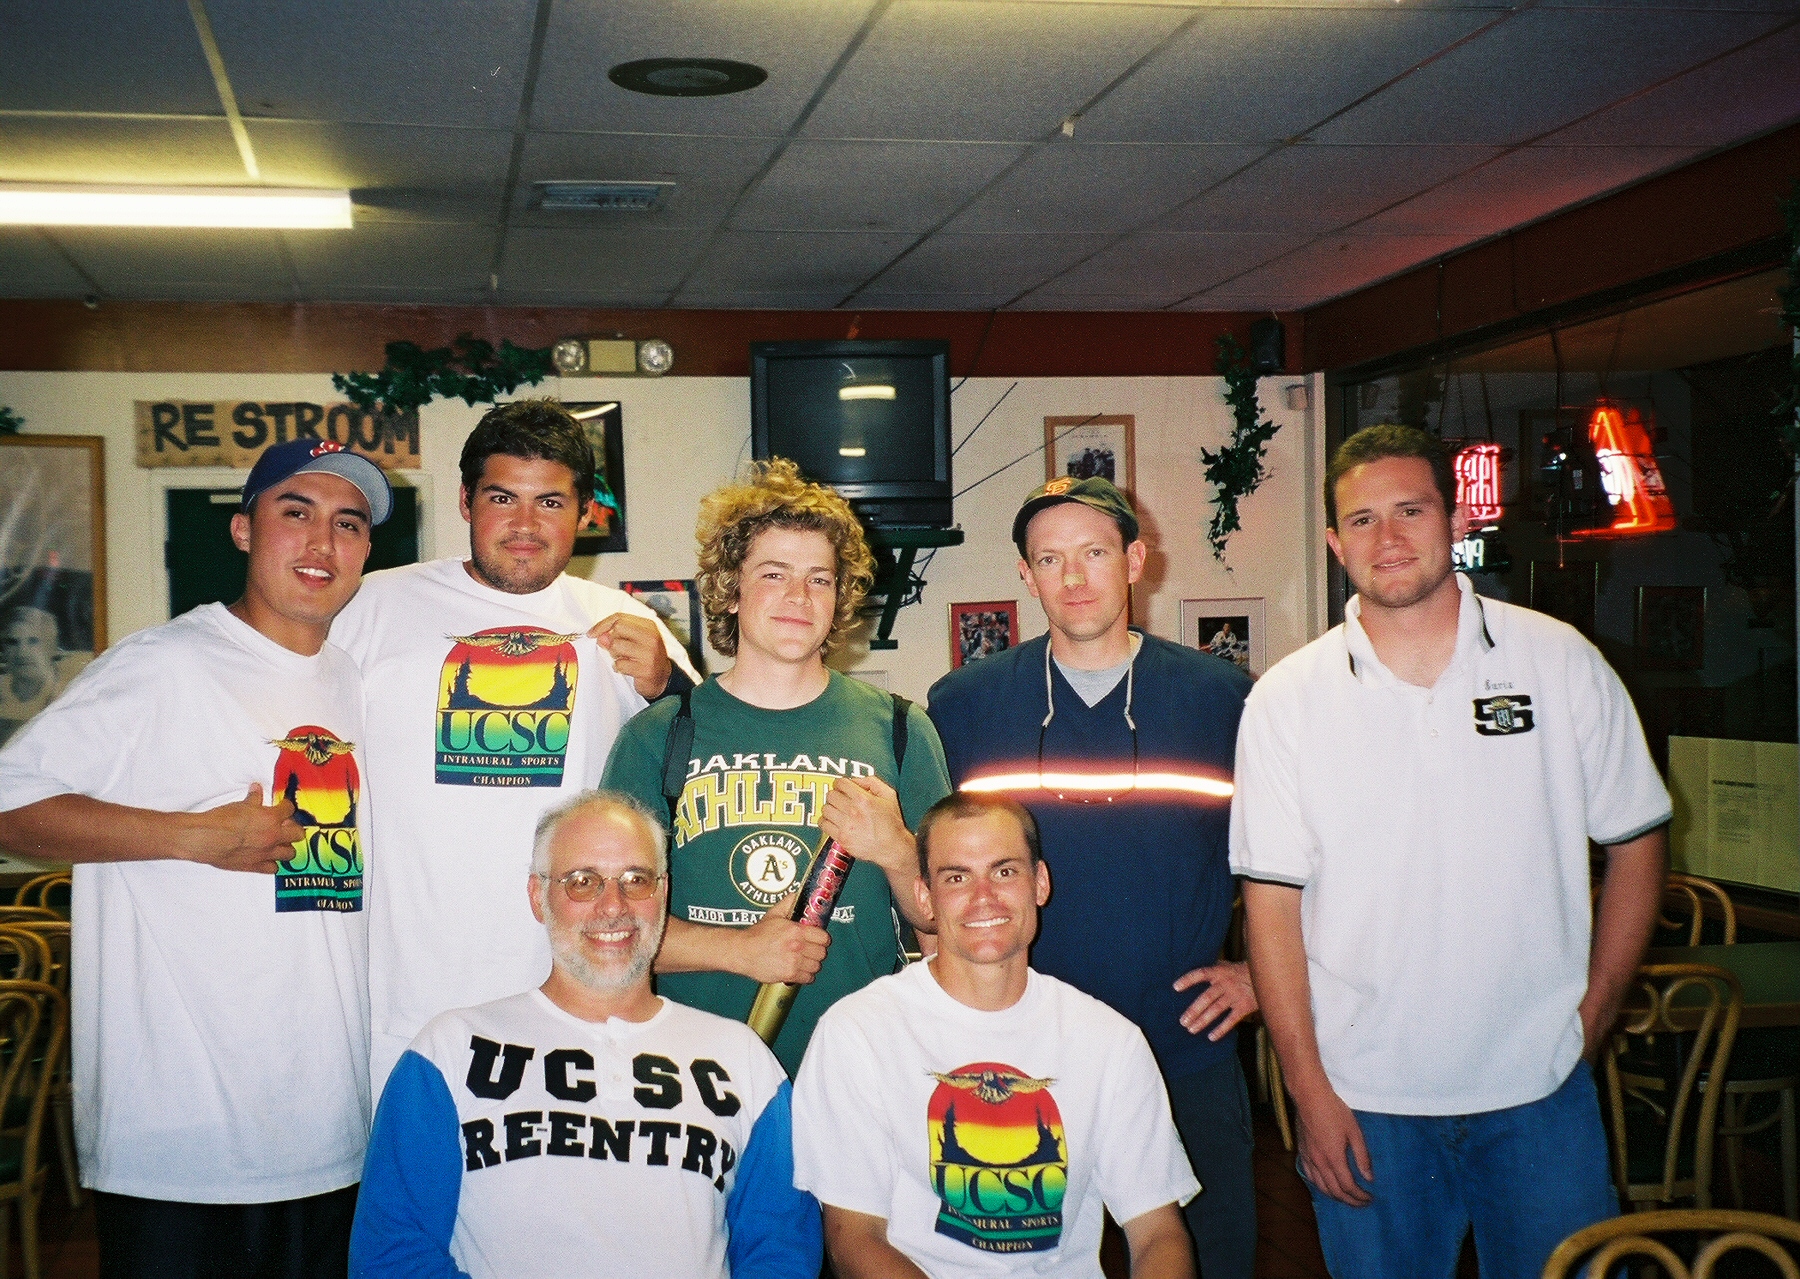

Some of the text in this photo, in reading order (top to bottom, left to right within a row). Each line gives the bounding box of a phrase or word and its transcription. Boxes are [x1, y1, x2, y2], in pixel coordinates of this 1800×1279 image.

[152, 402, 221, 452] RE
[440, 711, 571, 753] UCSC
[443, 754, 560, 766] INTRAMURAL SPORTS
[473, 775, 532, 786] CHAMPION
[674, 770, 843, 848] ATHLET
[742, 835, 802, 856] OAKLAND
[740, 880, 801, 903] ATHLETICS
[688, 907, 726, 922] MAJOR
[732, 911, 764, 924] LEA
[935, 1164, 1067, 1215] UCSC
[1021, 1216, 1060, 1229] SPORTS
[972, 1237, 1034, 1252] CHAMPION
